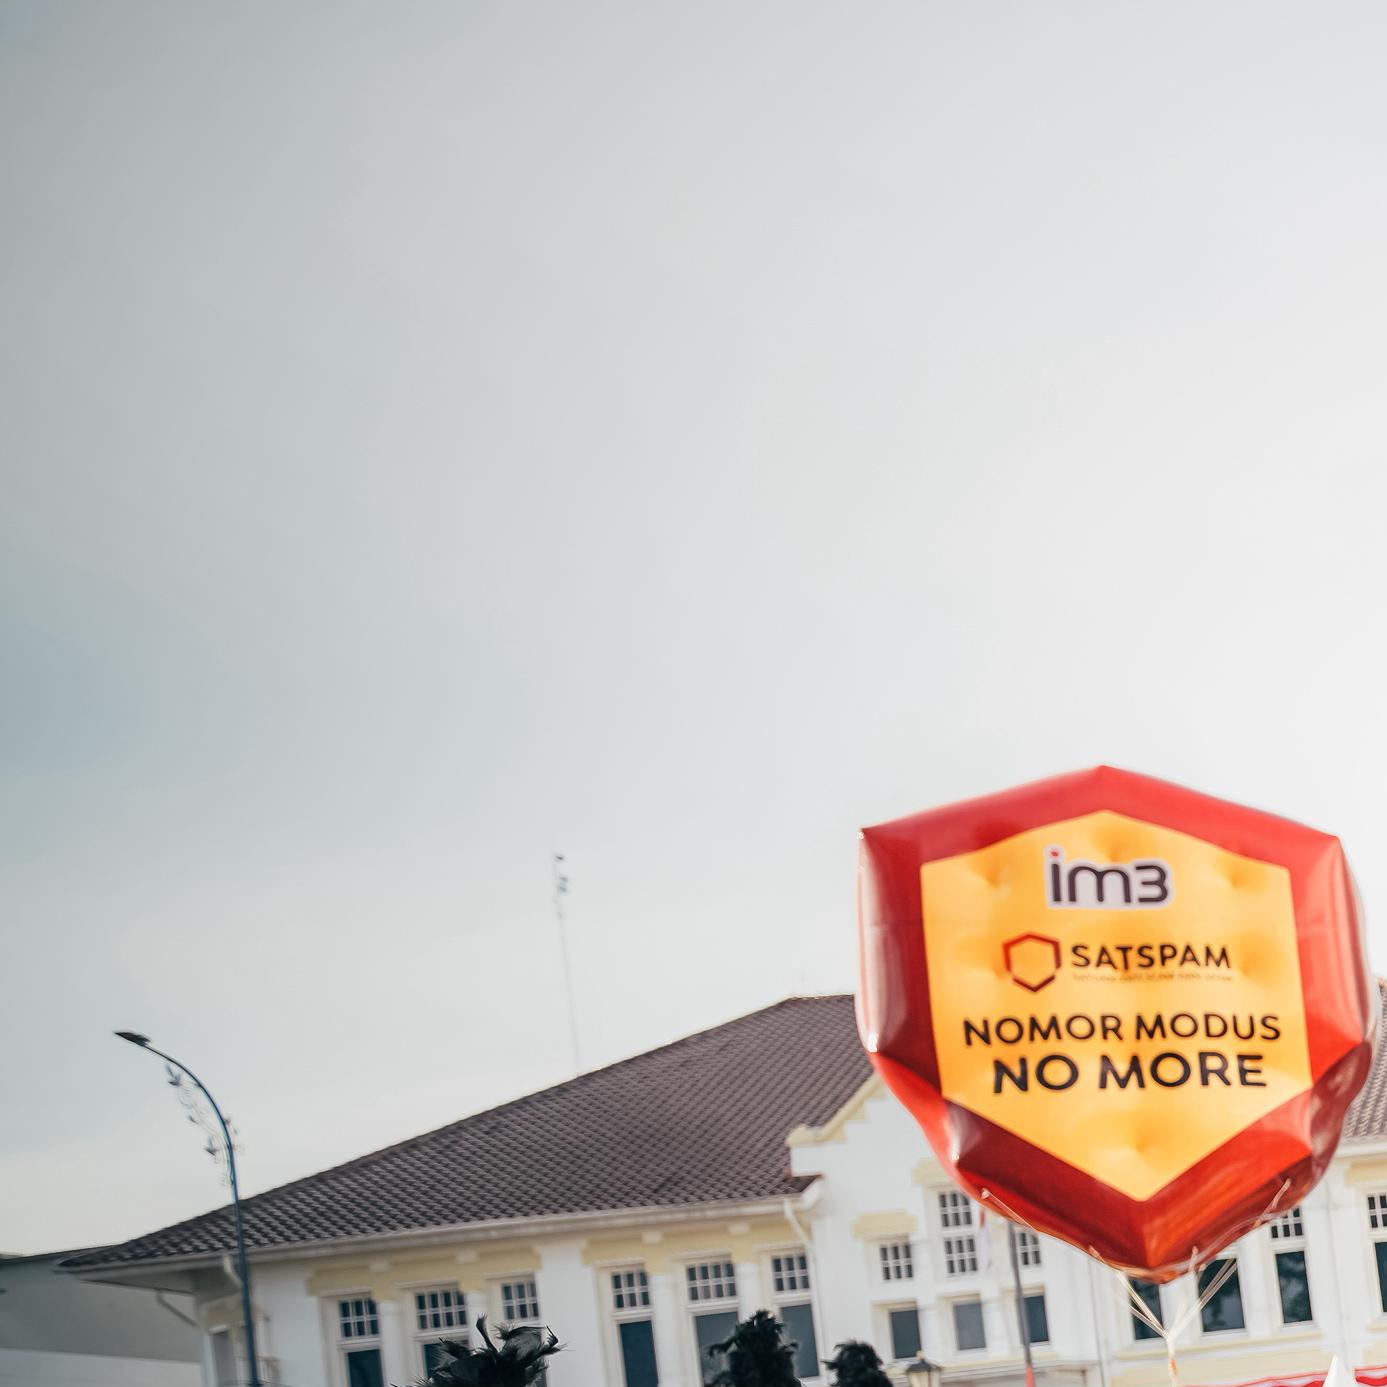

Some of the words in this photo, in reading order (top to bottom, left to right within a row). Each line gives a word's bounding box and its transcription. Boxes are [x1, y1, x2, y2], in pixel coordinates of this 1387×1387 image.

[1051, 848, 1169, 903] im3
[1071, 943, 1231, 971] SATSPAM
[963, 1013, 1122, 1047] NOMOR
[1136, 1013, 1282, 1042] MODUS
[993, 1053, 1079, 1094] NO
[1099, 1051, 1268, 1090] MORE
